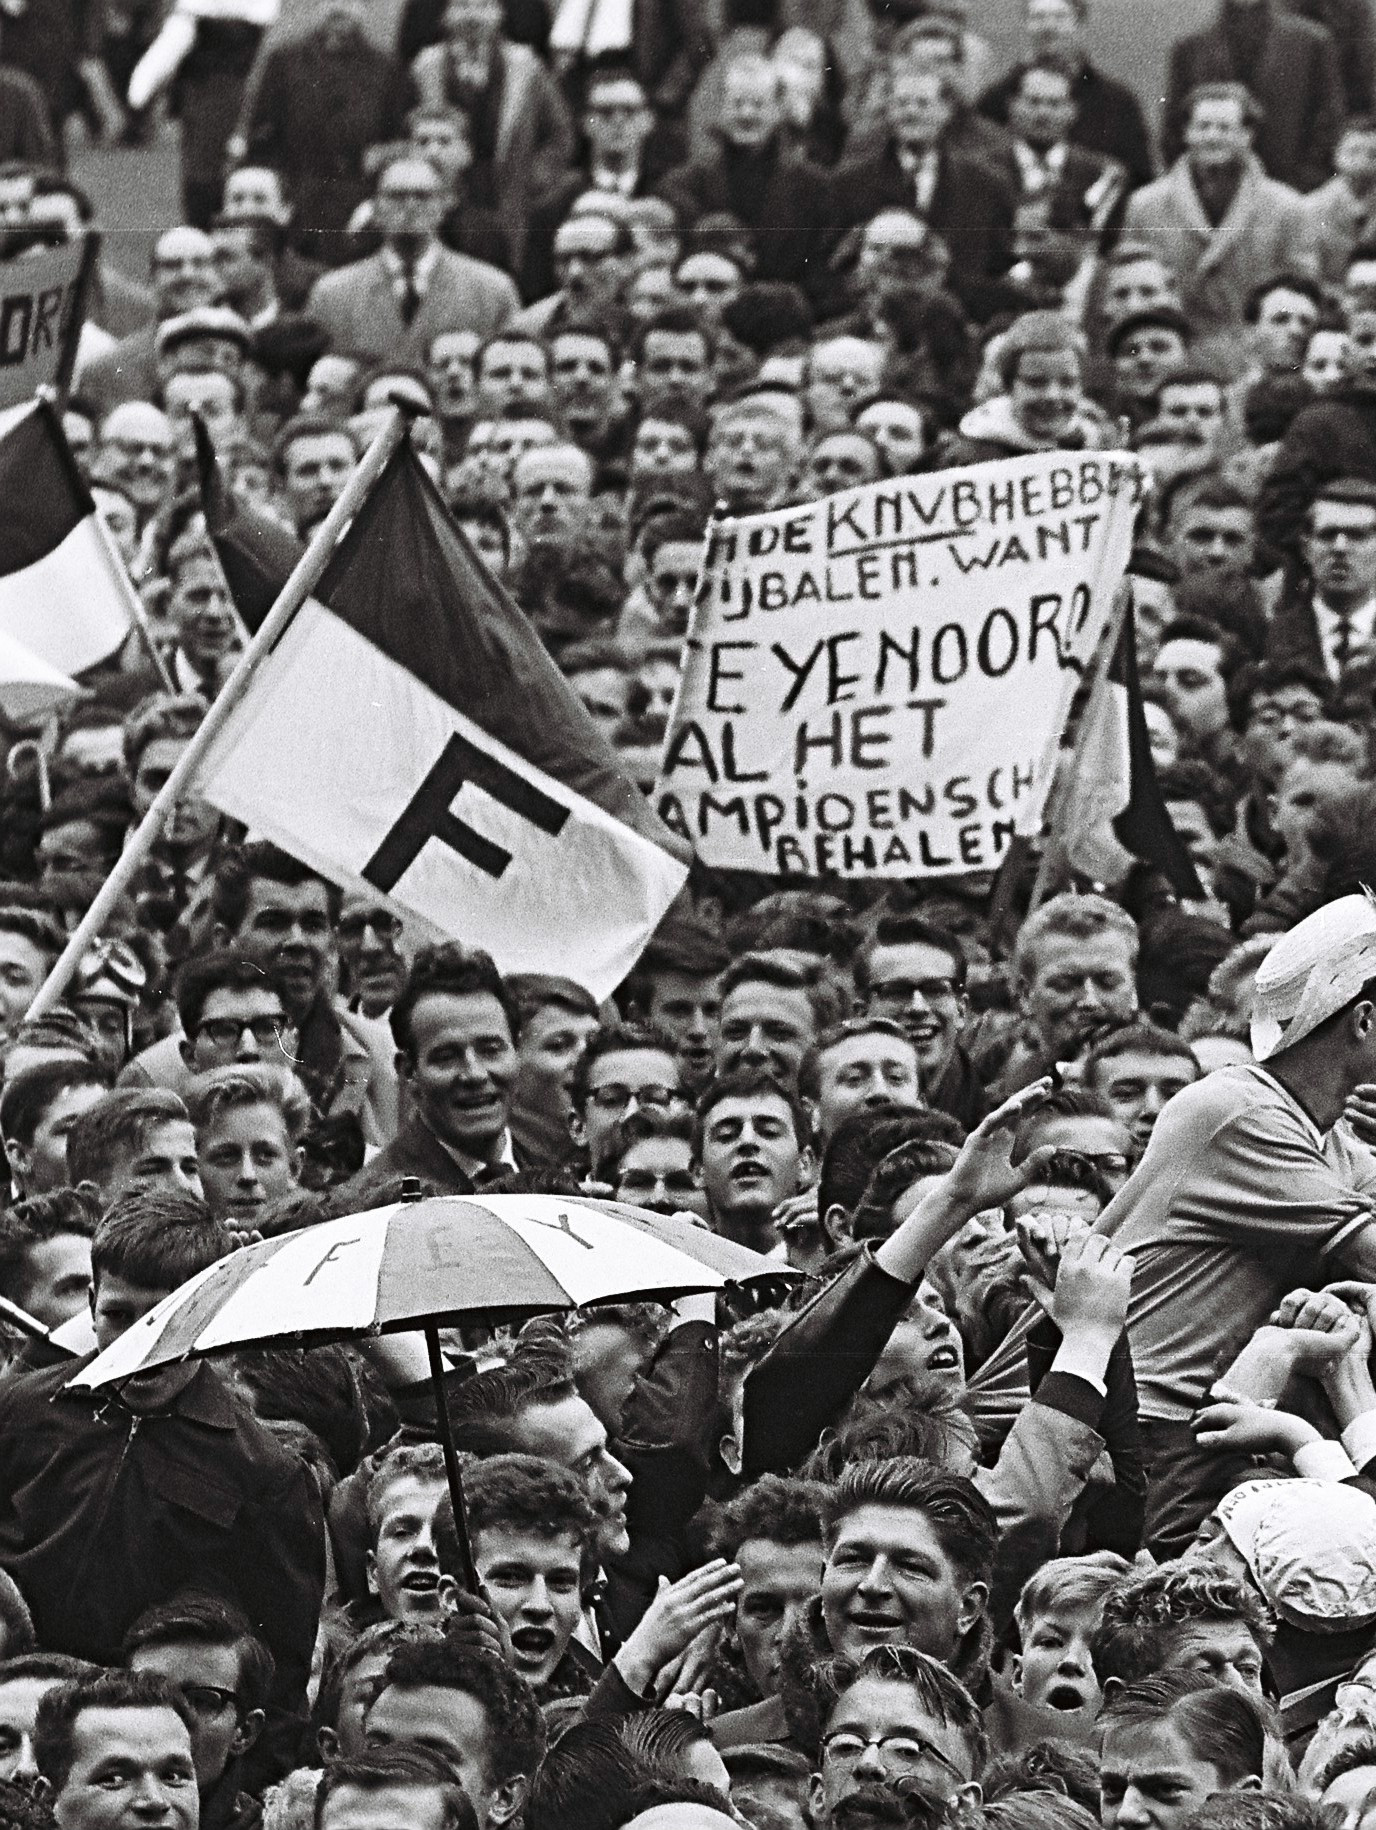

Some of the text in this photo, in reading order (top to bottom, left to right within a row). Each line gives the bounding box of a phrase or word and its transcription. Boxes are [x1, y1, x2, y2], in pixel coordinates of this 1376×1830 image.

[749, 514, 812, 556] DE
[949, 514, 1102, 574] WANT
[795, 698, 947, 776] HET
[361, 731, 571, 894] F
